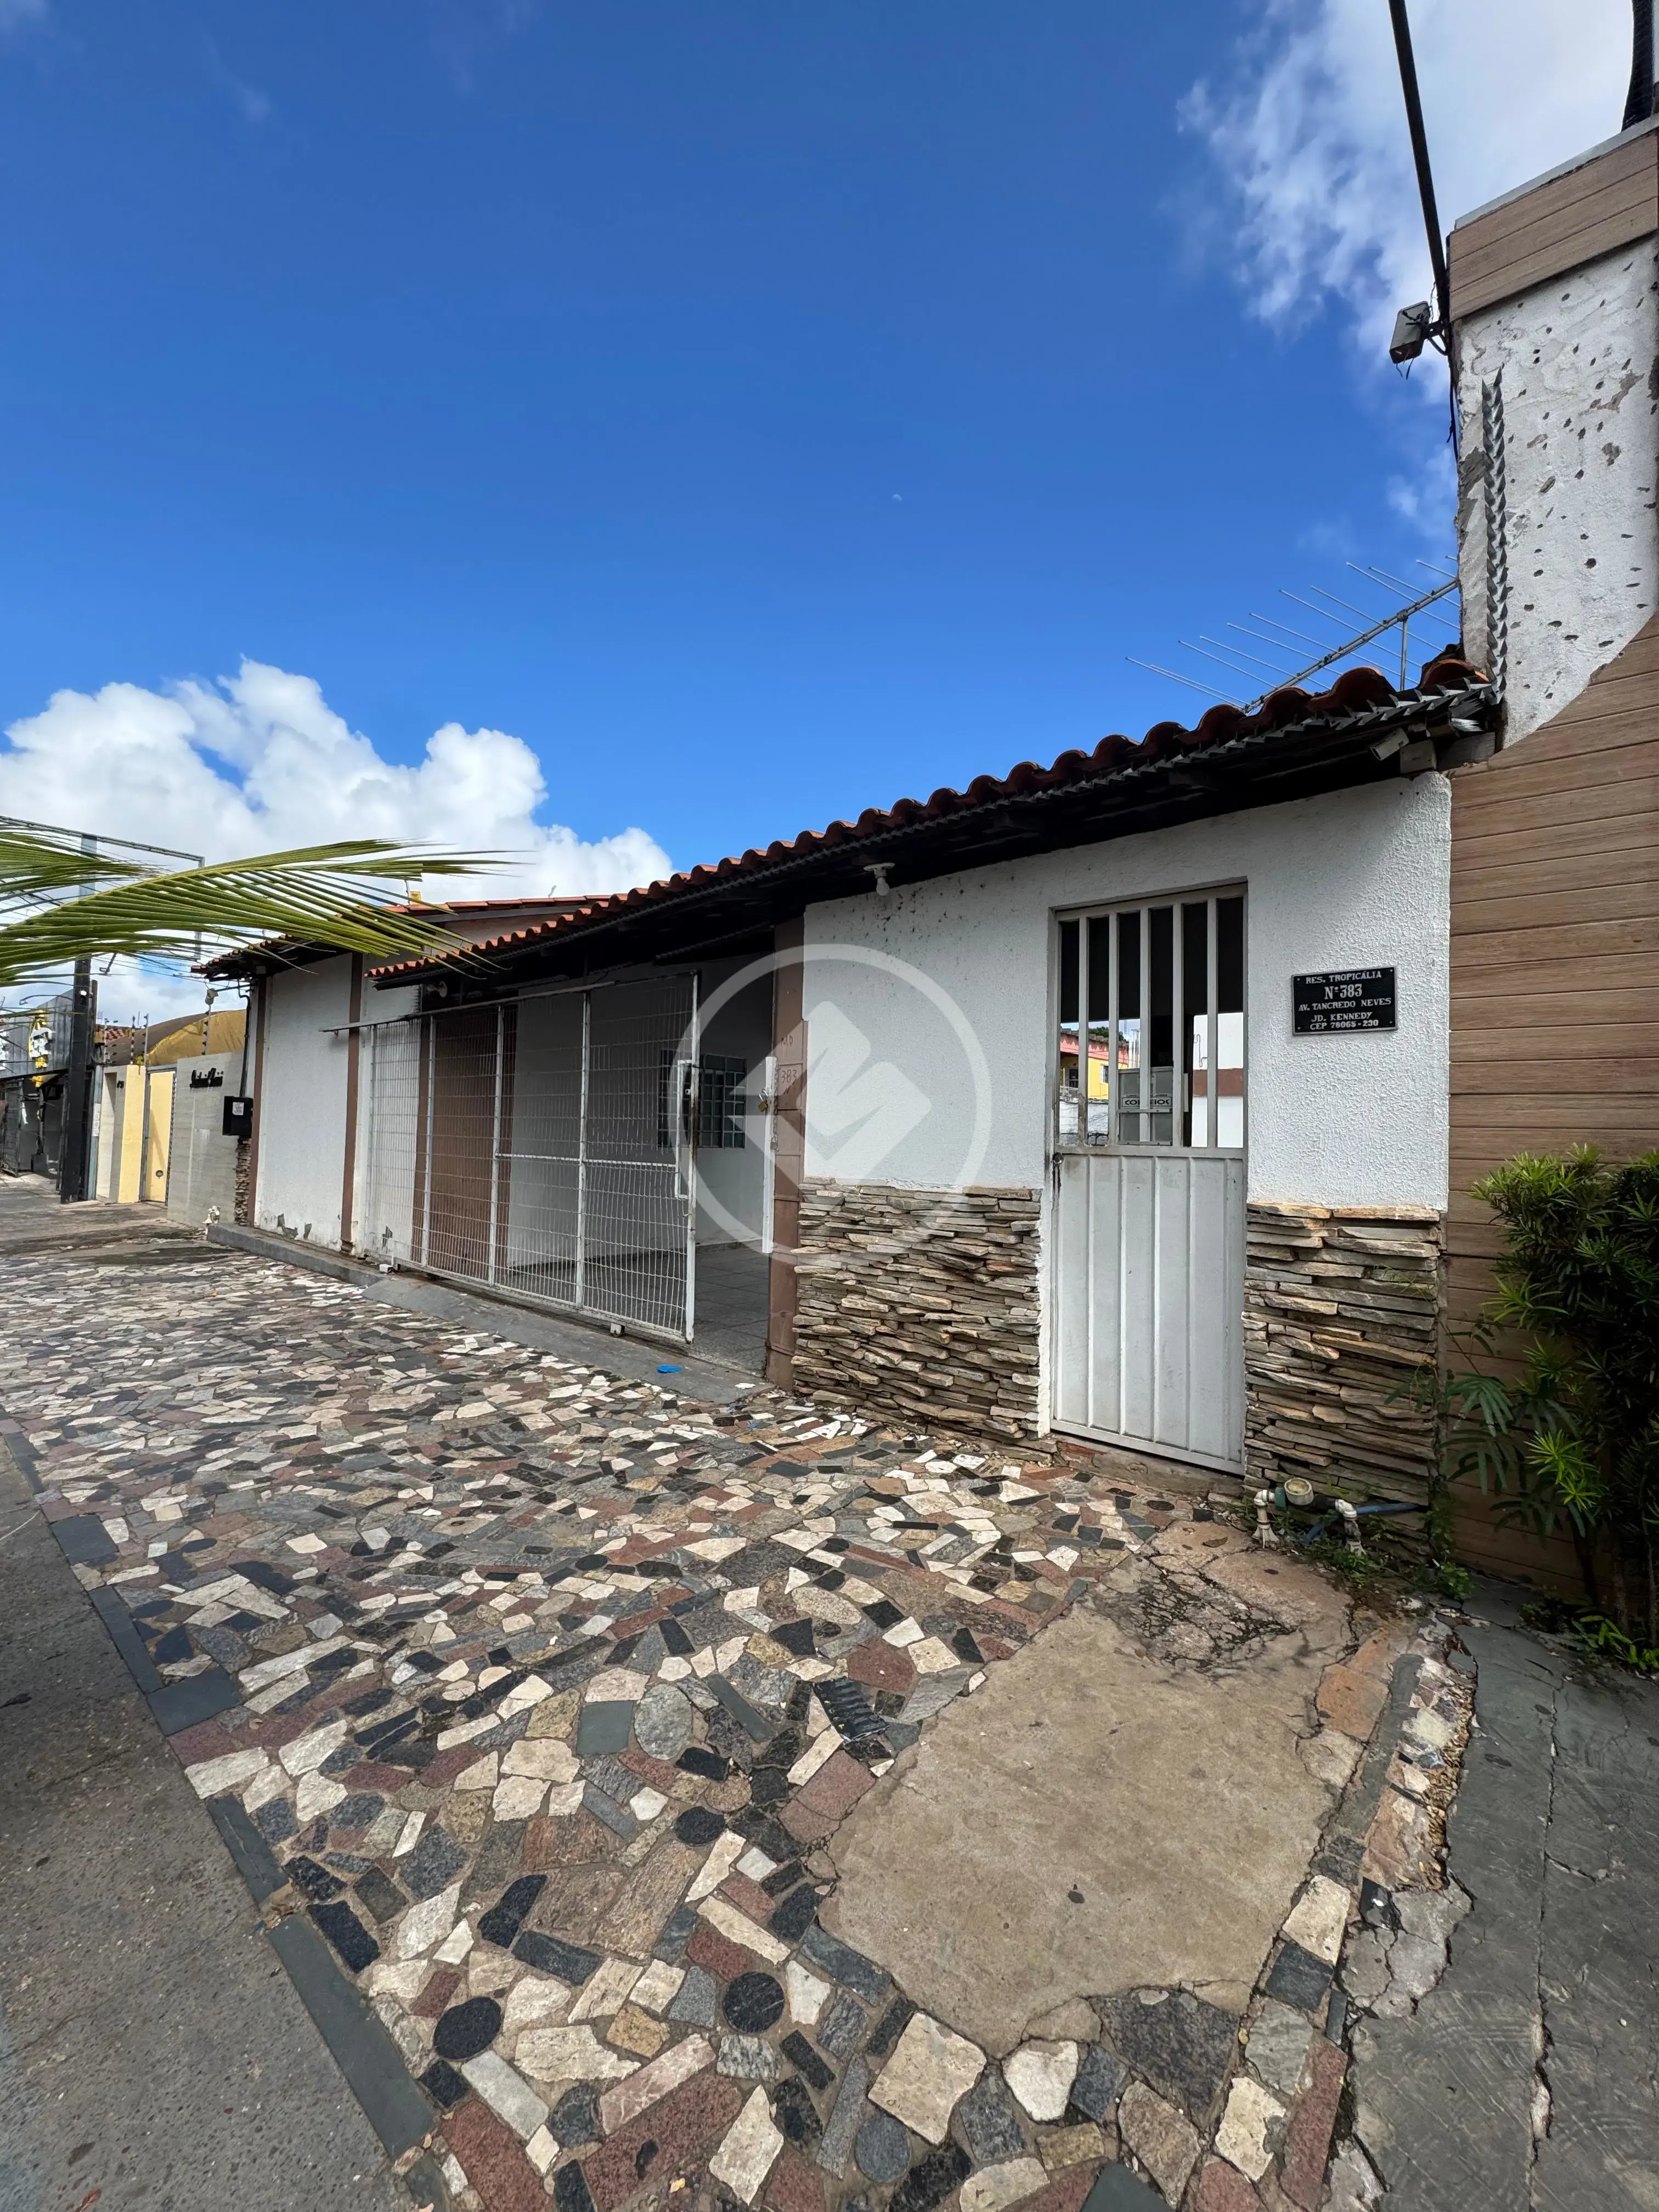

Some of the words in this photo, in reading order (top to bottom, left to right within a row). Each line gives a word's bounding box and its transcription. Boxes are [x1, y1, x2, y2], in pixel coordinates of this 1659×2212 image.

[1329, 970, 1381, 982] TROPICÁLIA
[1340, 984, 1362, 998] 383
[1312, 1001, 1356, 1011] TANCREDO
[1361, 997, 1392, 1007] NEVES
[1330, 1012, 1373, 1021] KENNEDY
[1310, 1022, 1327, 1030] CEP
[781, 1069, 797, 1083] 383
